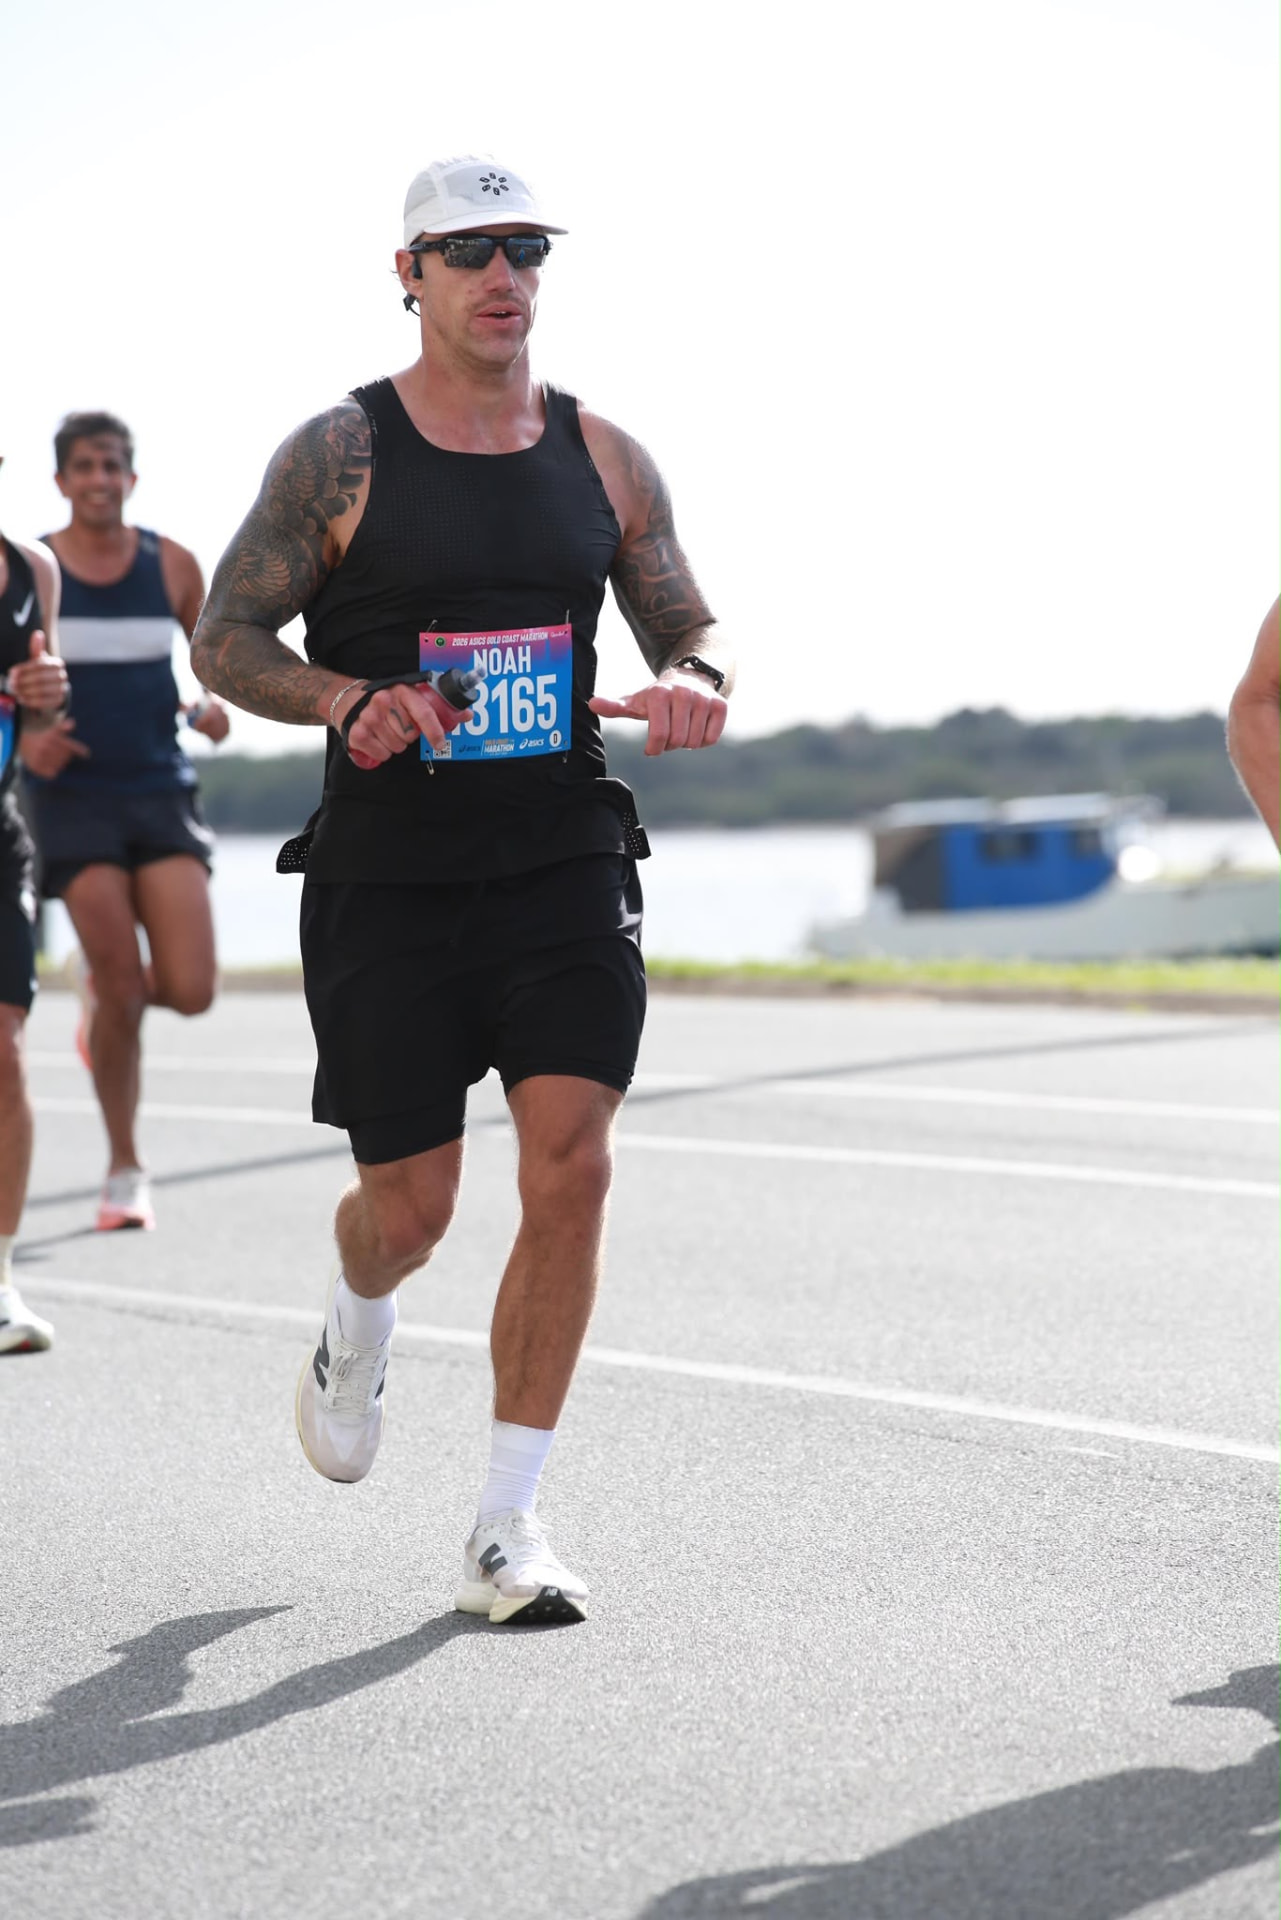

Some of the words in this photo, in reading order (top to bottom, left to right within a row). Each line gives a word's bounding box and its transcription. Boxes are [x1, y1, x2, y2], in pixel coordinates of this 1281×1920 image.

[452, 638, 468, 646] 2026
[469, 637, 486, 646] ASICS
[487, 636, 501, 645] GOLD
[502, 634, 520, 643] COAST
[520, 632, 548, 642] MARATHON
[473, 645, 532, 676] NOAH
[451, 674, 557, 736] 3165
[484, 743, 514, 753] MARATHON
